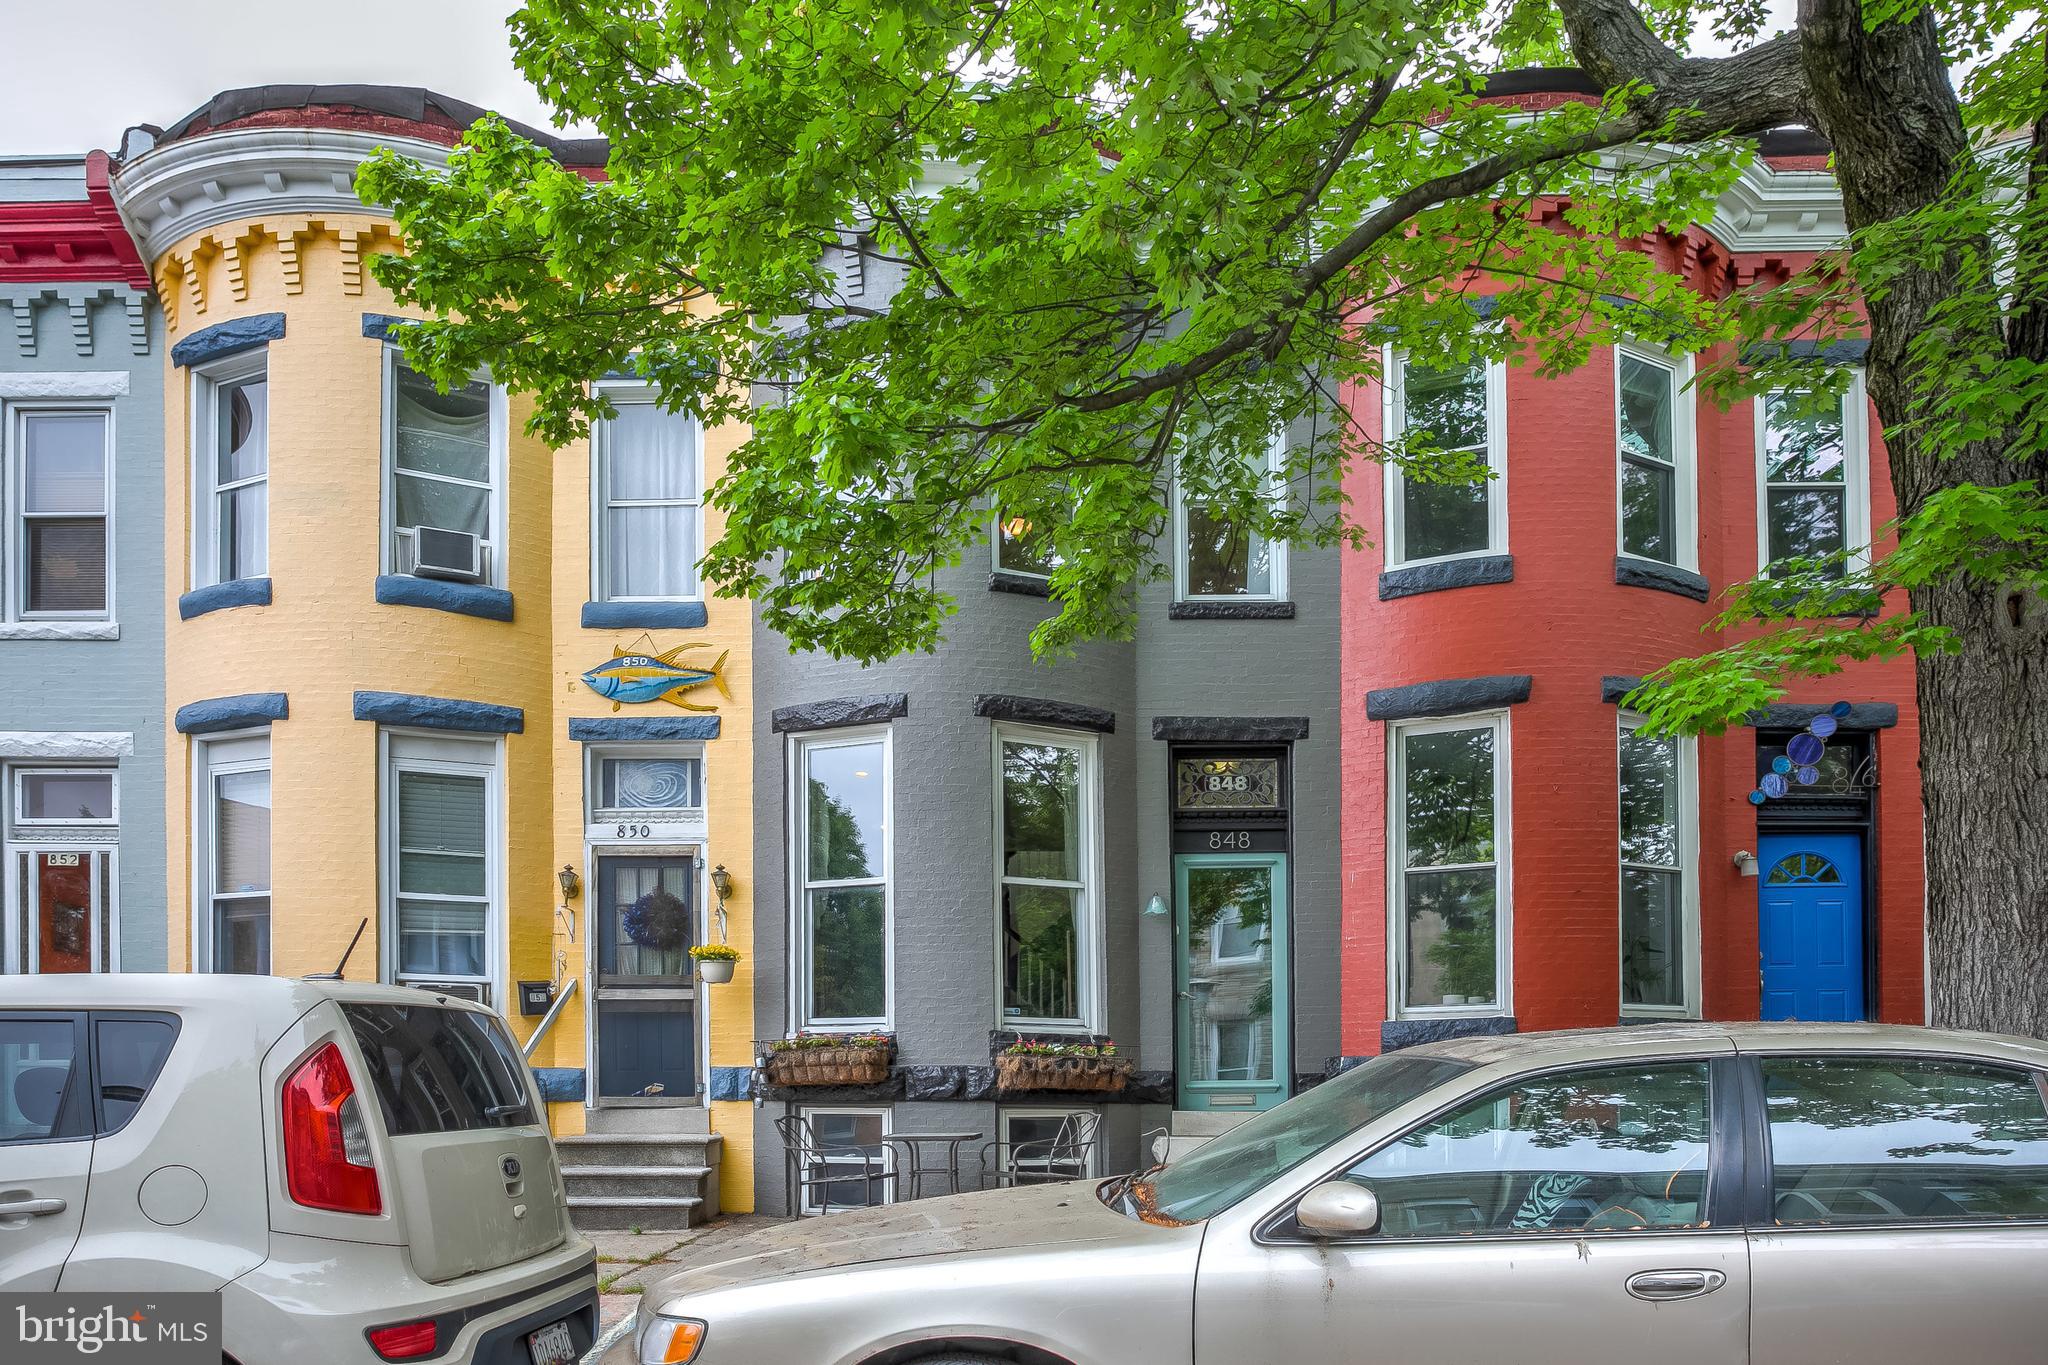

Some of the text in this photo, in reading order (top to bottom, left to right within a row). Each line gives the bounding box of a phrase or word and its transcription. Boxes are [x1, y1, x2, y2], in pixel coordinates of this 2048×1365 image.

[622, 657, 648, 667] 850
[1208, 775, 1248, 791] 848
[616, 824, 650, 838] 850
[1209, 831, 1251, 849] 848
[49, 853, 78, 865] 852
